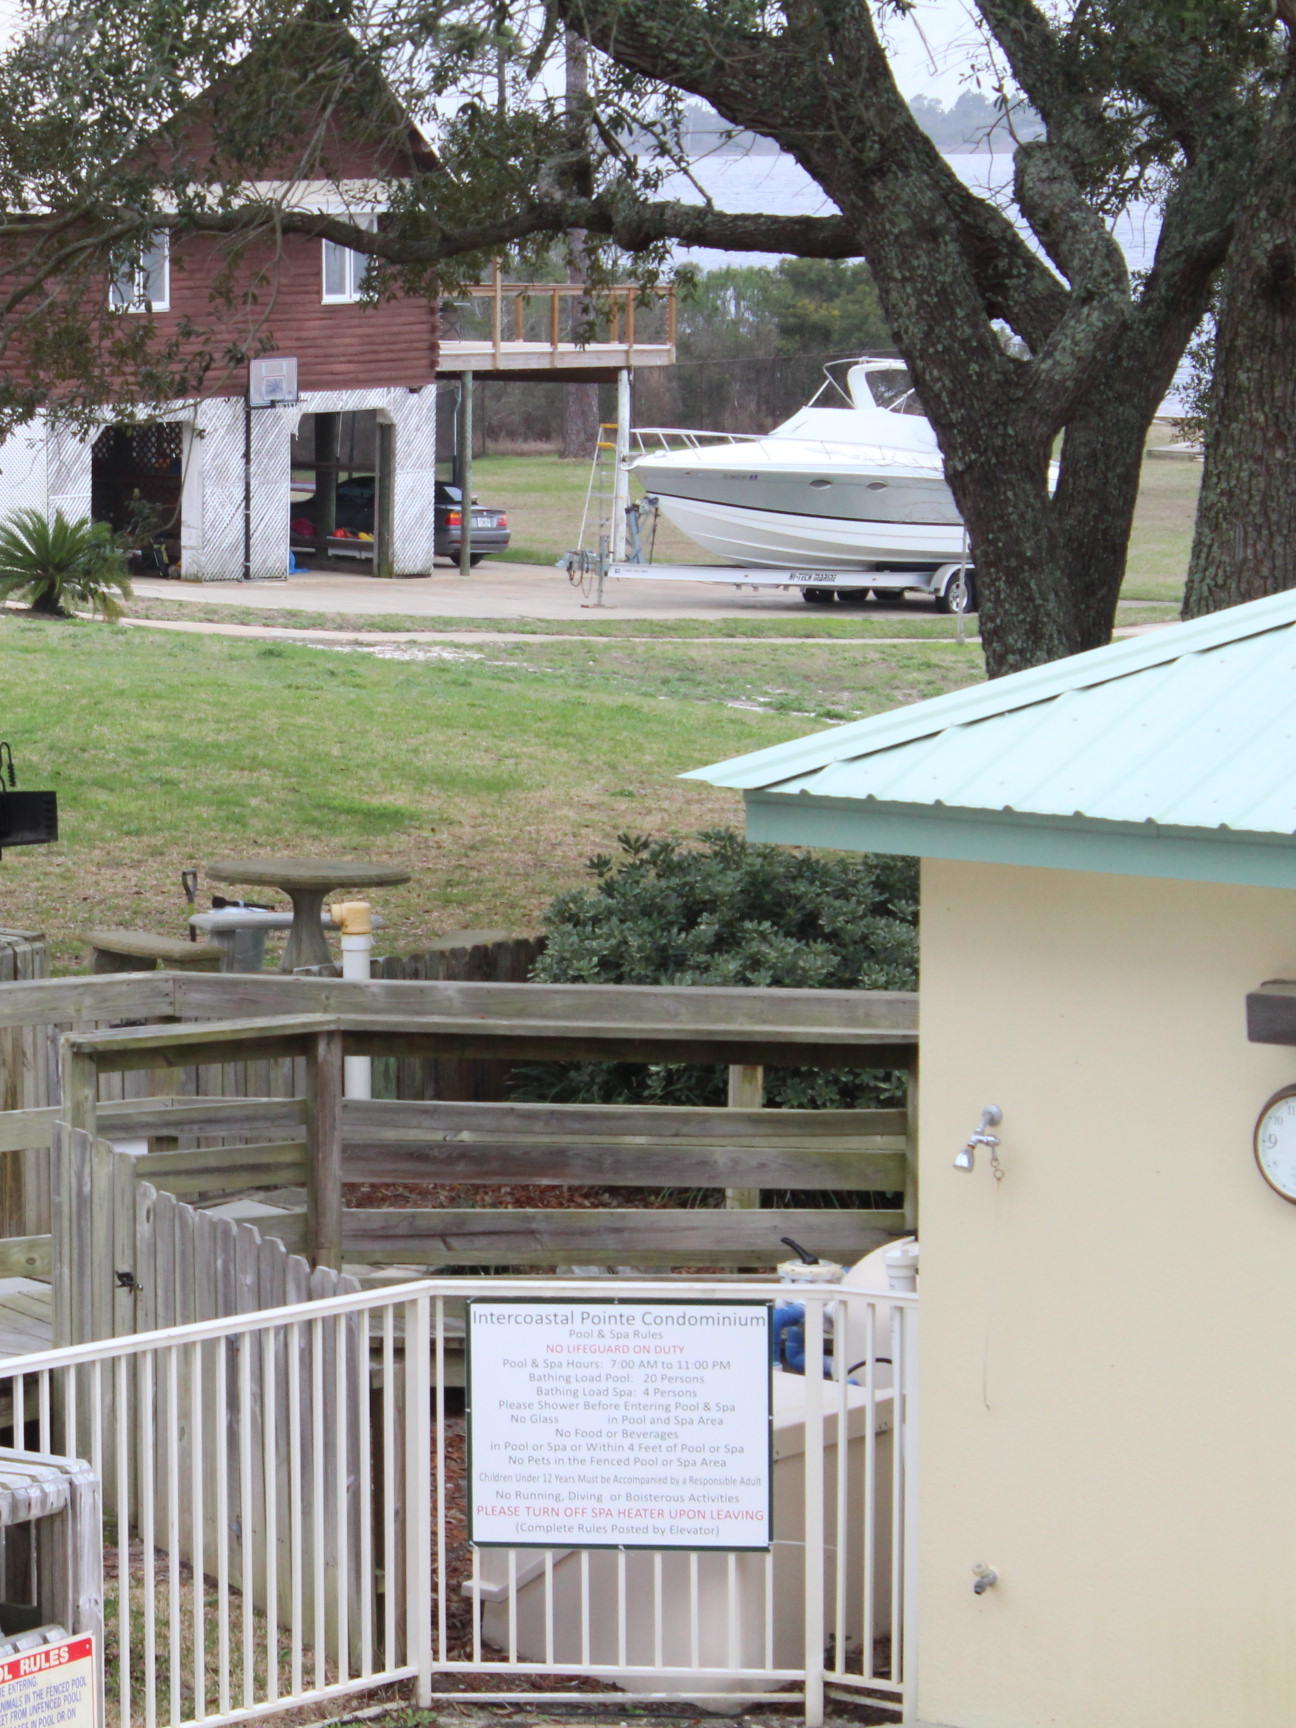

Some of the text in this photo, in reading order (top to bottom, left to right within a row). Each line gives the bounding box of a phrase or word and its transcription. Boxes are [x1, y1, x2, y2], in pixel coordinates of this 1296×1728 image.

[1267, 1133, 1278, 1149] 9
[473, 1311, 766, 1327] Intercoastal Pointe Condominium
[569, 1329, 663, 1340] Pool & Spa Rules
[546, 1344, 685, 1354] NO LIFEGUARD ON DUTY
[503, 1359, 527, 1368] Pool
[531, 1360, 539, 1368] &
[543, 1360, 563, 1370] Spa
[611, 1360, 635, 1369] 7:00
[638, 1360, 658, 1369] AM
[662, 1361, 673, 1369] to
[678, 1361, 708, 1369] 11:00
[712, 1361, 730, 1370] PM
[529, 1373, 571, 1384] Bathing
[575, 1373, 601, 1382] Load
[644, 1374, 657, 1383] 20
[661, 1375, 704, 1384] Persons
[537, 1387, 579, 1398] Bathing
[583, 1387, 608, 1396] Load
[643, 1388, 649, 1396] 4
[654, 1388, 697, 1397] Persons
[498, 1400, 735, 1413] Please Shower Before Entering Pool & Spa
[511, 1415, 723, 1426] No Glass in Pool and Spa Area
[555, 1429, 571, 1437] No
[575, 1429, 602, 1438] Food
[622, 1430, 679, 1441] Beverages
[491, 1442, 500, 1450] in
[504, 1442, 528, 1450] Pool
[548, 1443, 567, 1452] Spa
[587, 1443, 624, 1452] Within
[628, 1444, 634, 1452] 4
[639, 1444, 662, 1453] Feet
[666, 1444, 677, 1453] of
[681, 1444, 705, 1453] Pool
[724, 1445, 744, 1455] Spa
[509, 1456, 524, 1464] No
[528, 1456, 550, 1465] Pets
[555, 1457, 564, 1465] in
[568, 1457, 586, 1465] the
[591, 1457, 629, 1465] Fenced
[634, 1457, 658, 1466] Pool
[677, 1458, 696, 1468] Spa
[700, 1458, 726, 1467] Area
[479, 1472, 512, 1482] Children
[515, 1474, 540, 1482] Under
[543, 1474, 551, 1482] 12
[555, 1474, 575, 1483] Years
[578, 1475, 598, 1483] Must
[601, 1475, 611, 1483] be
[613, 1475, 667, 1486] Accompanied
[670, 1476, 679, 1486] by
[689, 1476, 737, 1486] Responsible
[739, 1477, 761, 1486] Adult
[496, 1490, 511, 1499] No
[568, 1491, 602, 1502] Diving
[626, 1493, 685, 1502] Boisterous
[688, 1493, 739, 1503] Activities
[477, 1506, 764, 1521] PLEASE TURN OFF SPA HEATER UPON LEAVING
[516, 1523, 719, 1536] (Complete Rules Posted by Elevator)
[20, 1647, 69, 1676] RULES
[24, 1693, 31, 1704] IN
[32, 1689, 44, 1701] THE
[46, 1681, 70, 1697] FENCED
[10, 1708, 27, 1720] FROM
[29, 1696, 62, 1716] UNFENCED
[38, 1716, 54, 1728] POOL
[57, 1711, 65, 1722] OR
[67, 1708, 76, 1720] ON
